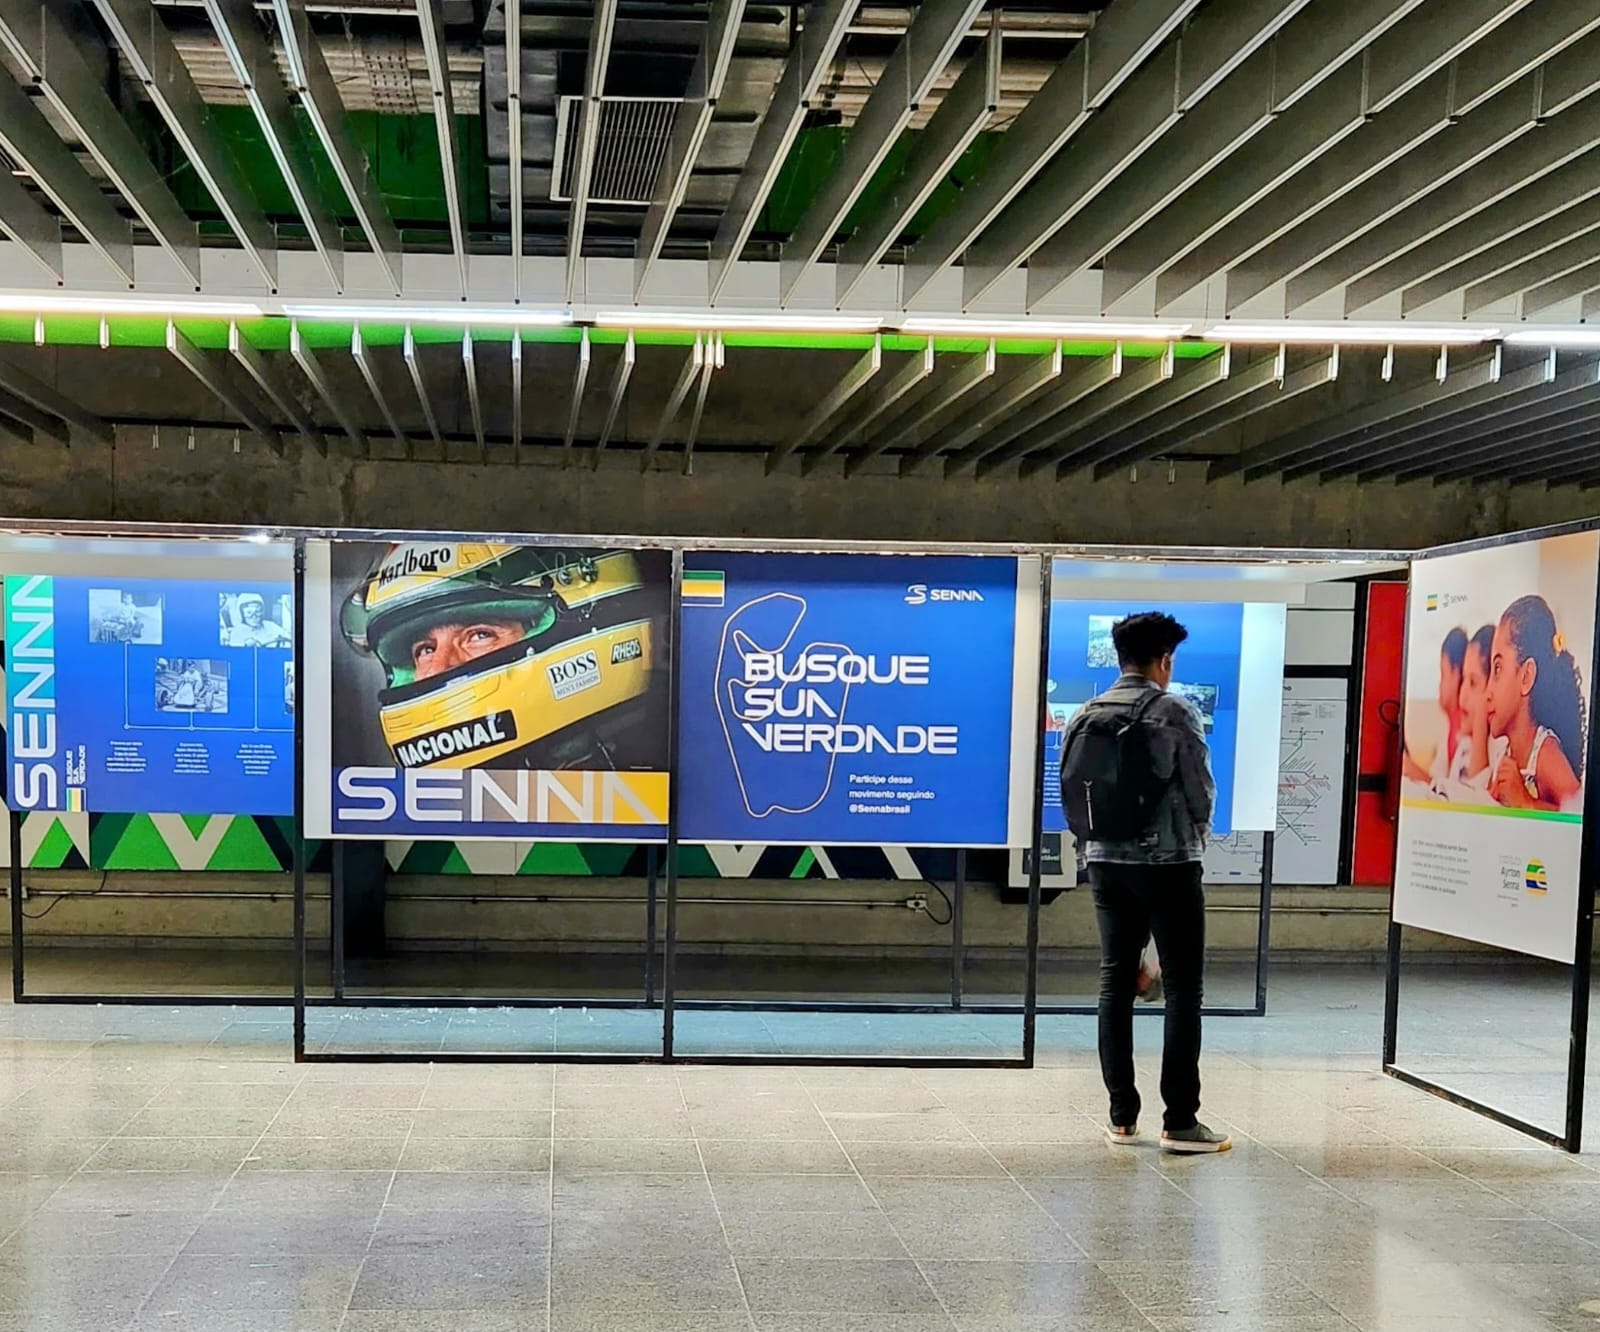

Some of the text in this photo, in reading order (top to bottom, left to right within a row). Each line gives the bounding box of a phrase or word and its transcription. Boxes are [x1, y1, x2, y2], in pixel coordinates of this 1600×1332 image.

[379, 547, 451, 586] Marlboro
[930, 589, 985, 601] SENNA
[549, 652, 598, 684] BOSS
[744, 653, 930, 685] BUSQUE
[743, 688, 837, 719] SUA
[397, 719, 506, 767] NACIONAL
[742, 723, 958, 754] VERDADE
[849, 774, 887, 785] Participe
[849, 789, 935, 801] movimento seguindo
[337, 766, 663, 825] SENNA
[849, 804, 911, 814] @Sennabrasil
